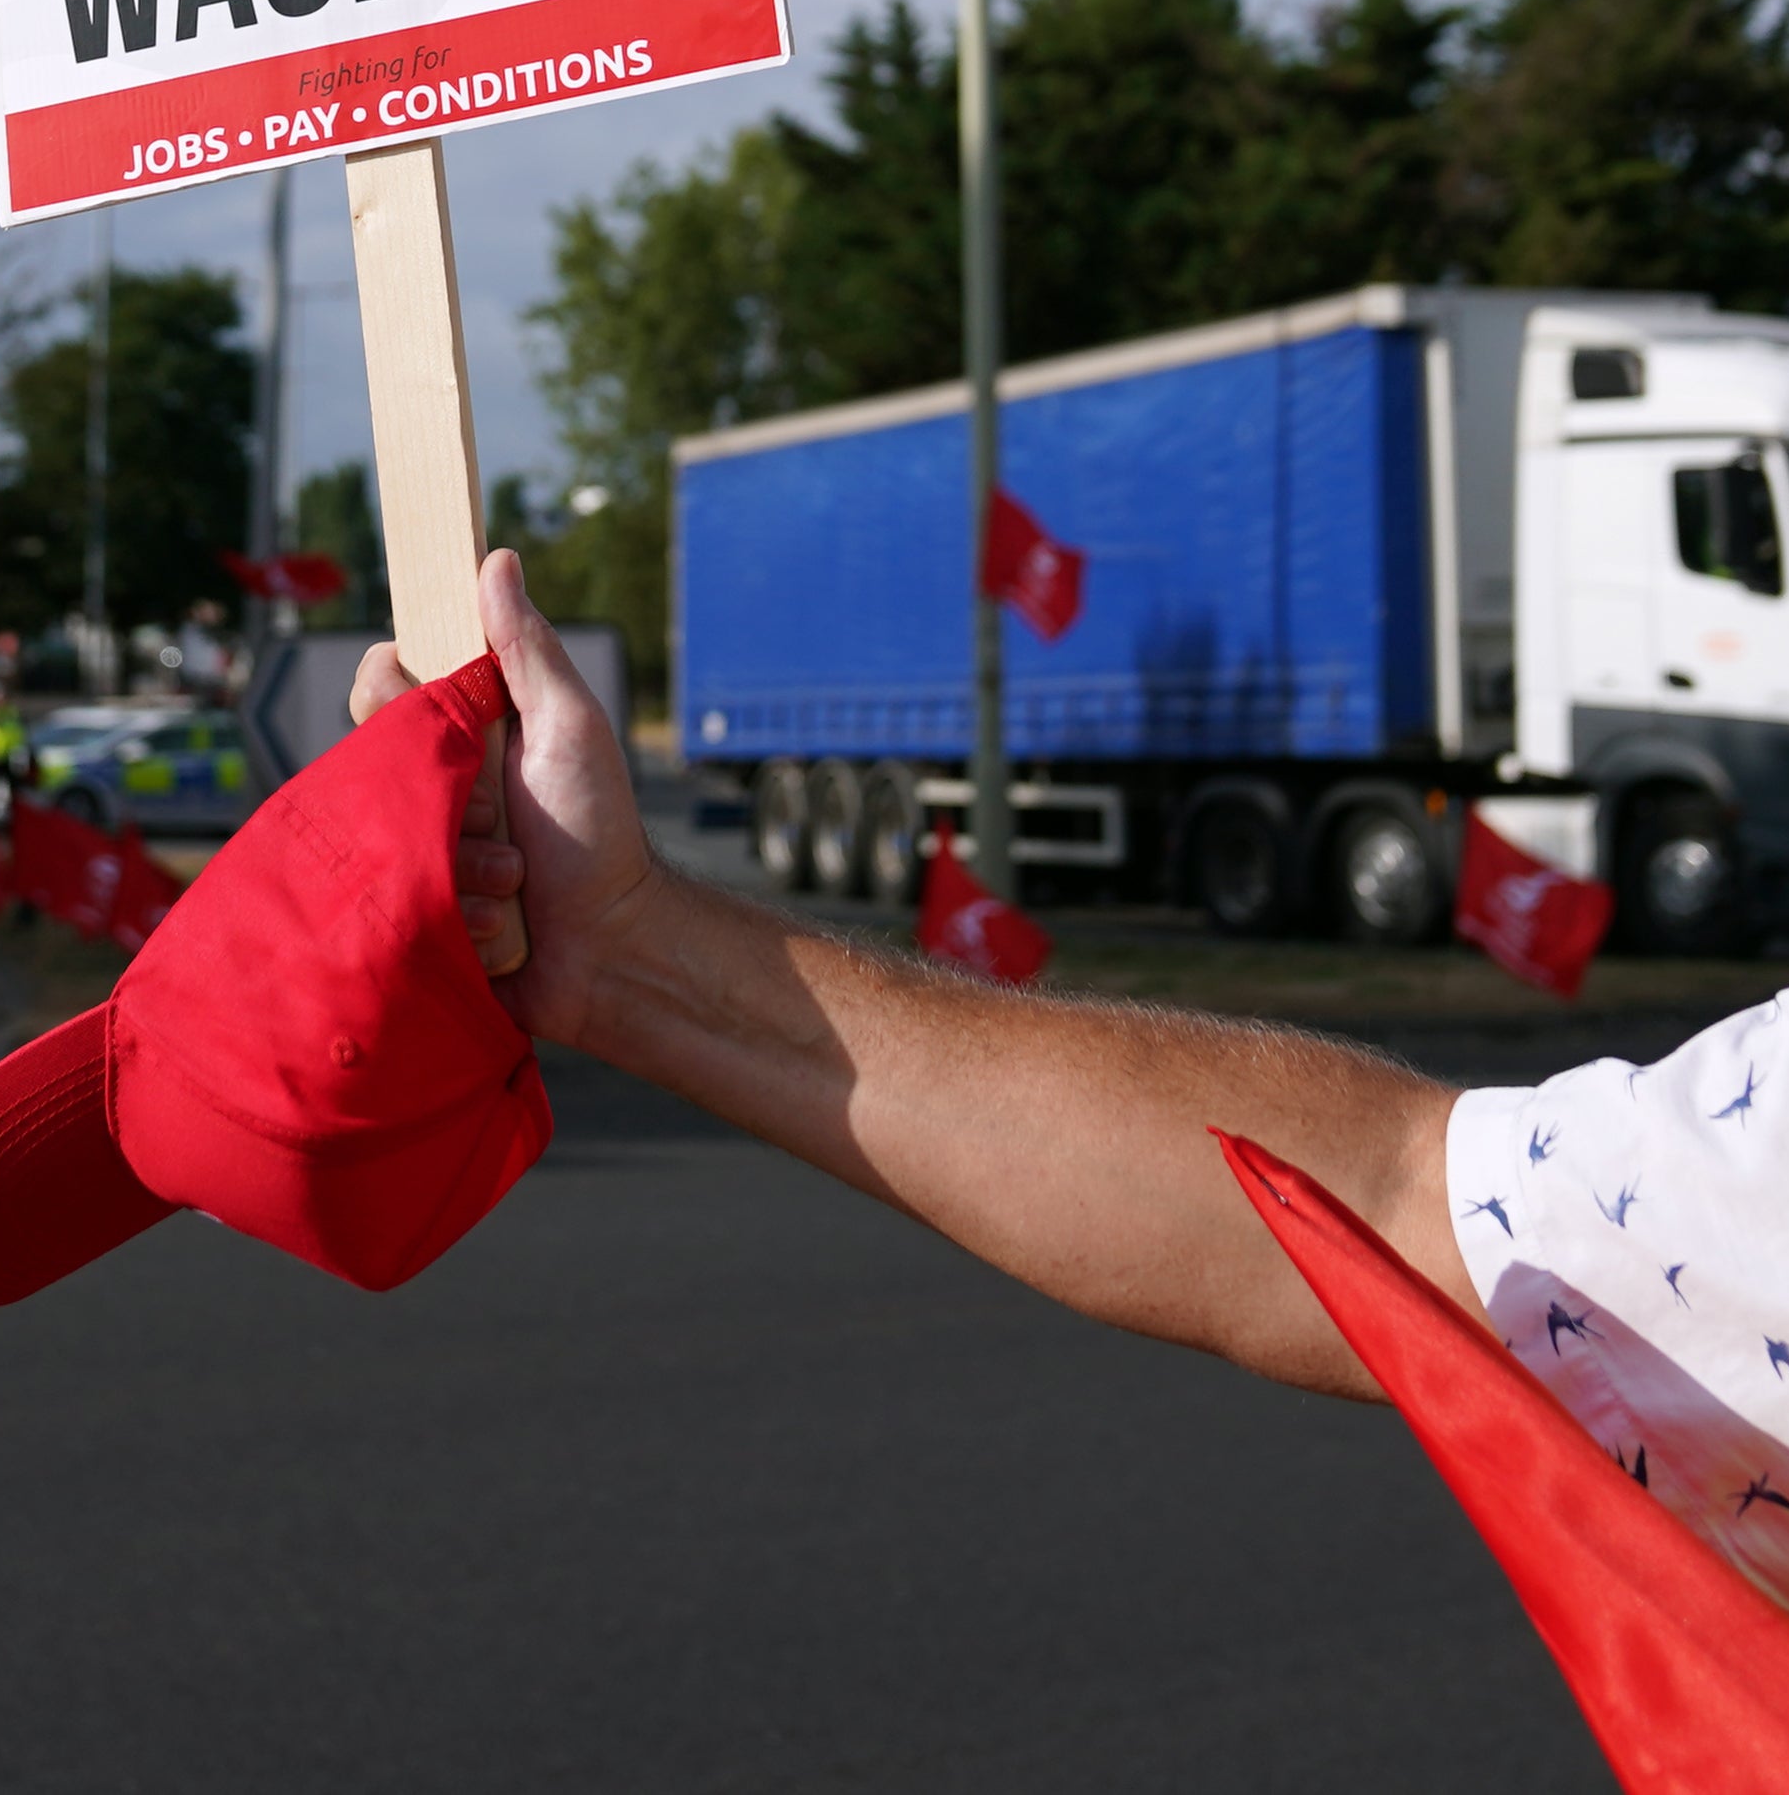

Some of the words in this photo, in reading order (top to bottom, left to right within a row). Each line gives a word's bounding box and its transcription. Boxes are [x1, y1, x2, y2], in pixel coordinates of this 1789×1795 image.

[123, 127, 229, 181] JOBS
[264, 102, 340, 151] PAY
[378, 39, 655, 127] CONDITIONS
[298, 58, 405, 99] Fighting
[410, 44, 452, 80] for
